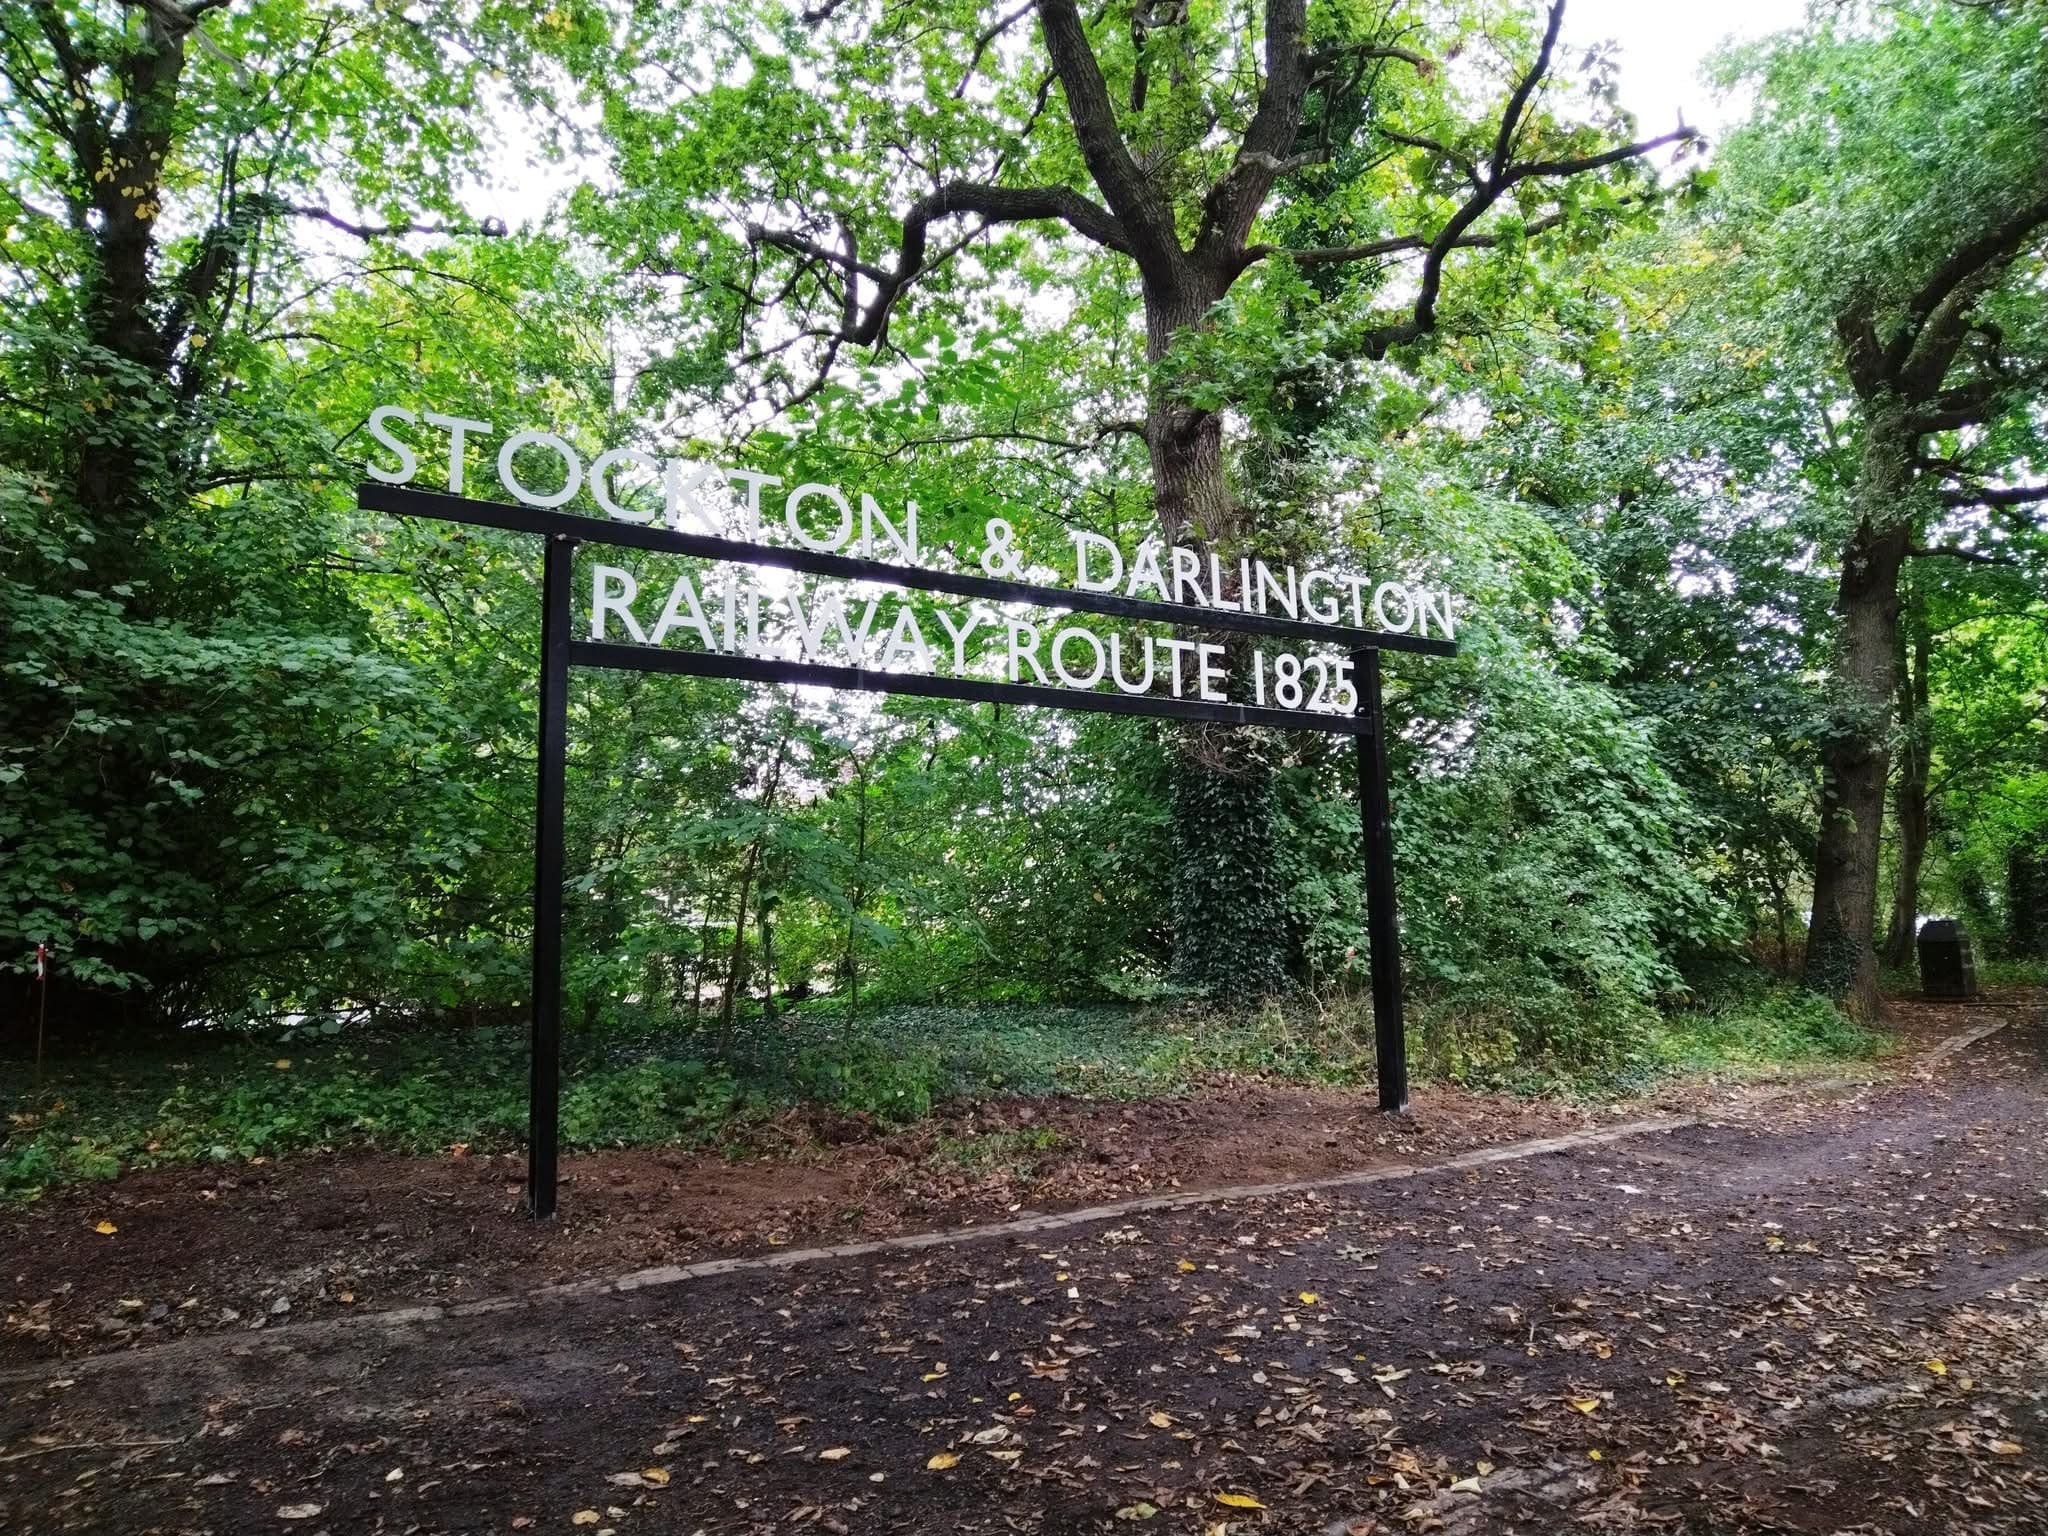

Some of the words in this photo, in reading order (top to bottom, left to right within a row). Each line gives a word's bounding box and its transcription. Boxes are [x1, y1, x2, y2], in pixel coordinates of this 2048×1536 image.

[366, 405, 918, 566] STOCKTON
[980, 518, 1024, 579] &
[1076, 532, 1455, 641] DARLINGTON
[591, 565, 983, 676] RAILWAY
[1008, 619, 1228, 702] ROUTE
[1253, 650, 1358, 714] 1825
